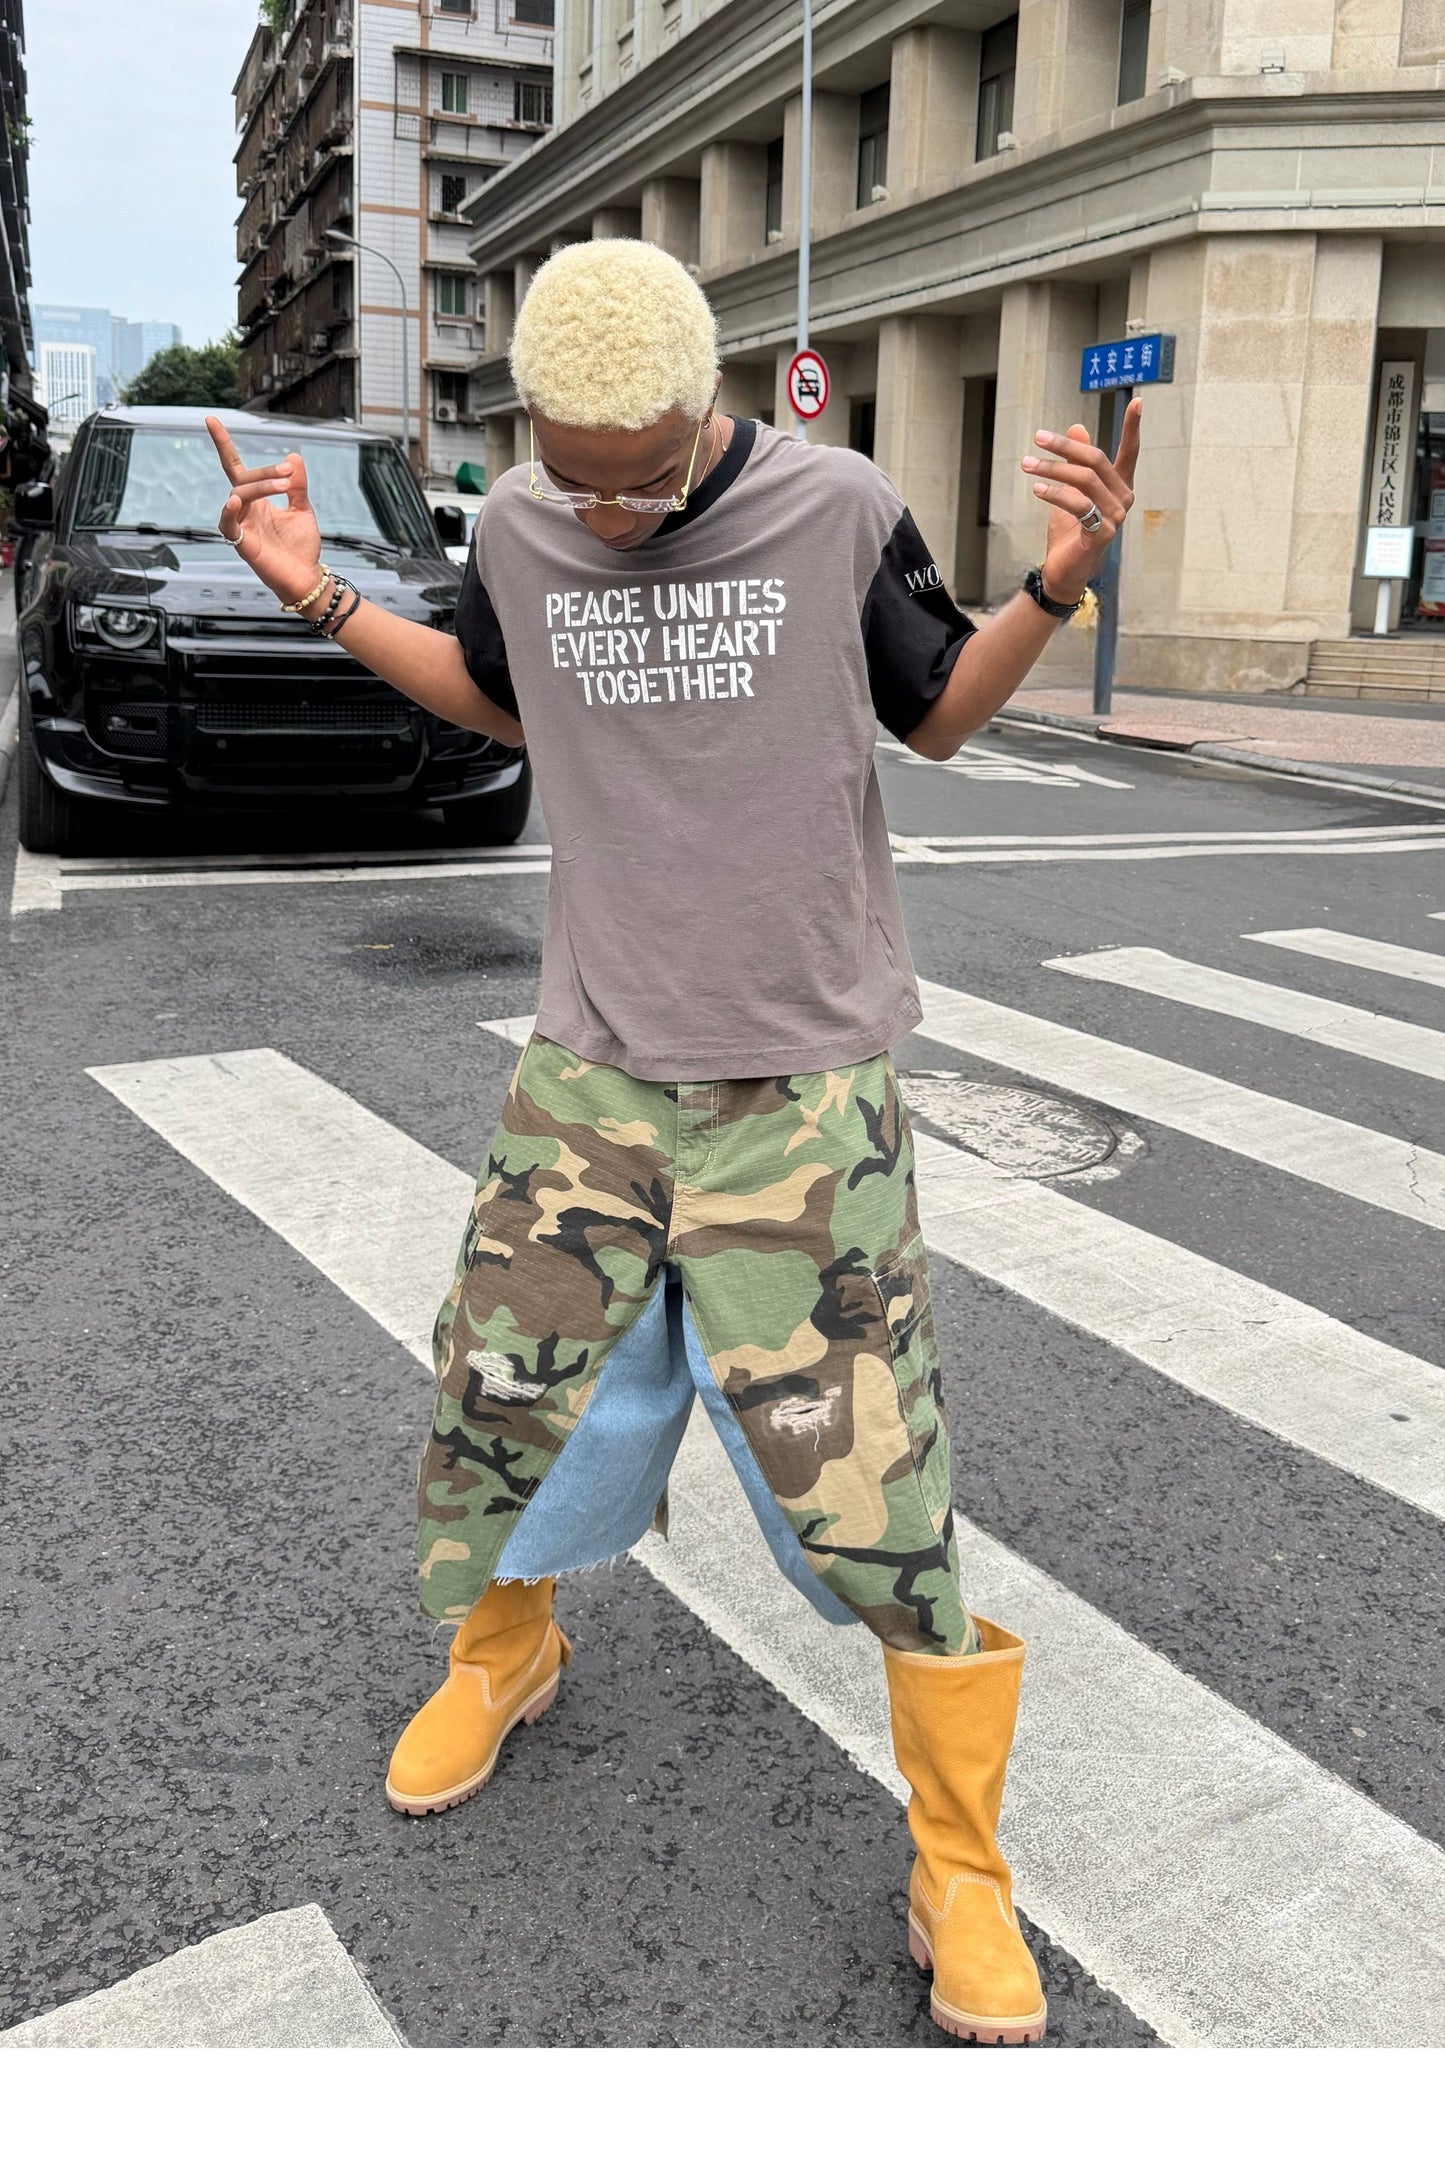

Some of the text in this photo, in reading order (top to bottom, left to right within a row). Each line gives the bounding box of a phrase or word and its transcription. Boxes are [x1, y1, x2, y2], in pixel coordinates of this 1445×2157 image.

[1089, 343, 1153, 376] 大安正街
[904, 564, 942, 590] WO
[546, 579, 787, 628] PEACE UNITES
[551, 619, 783, 668] EVERY HEART
[576, 661, 755, 705] TOGETHER
